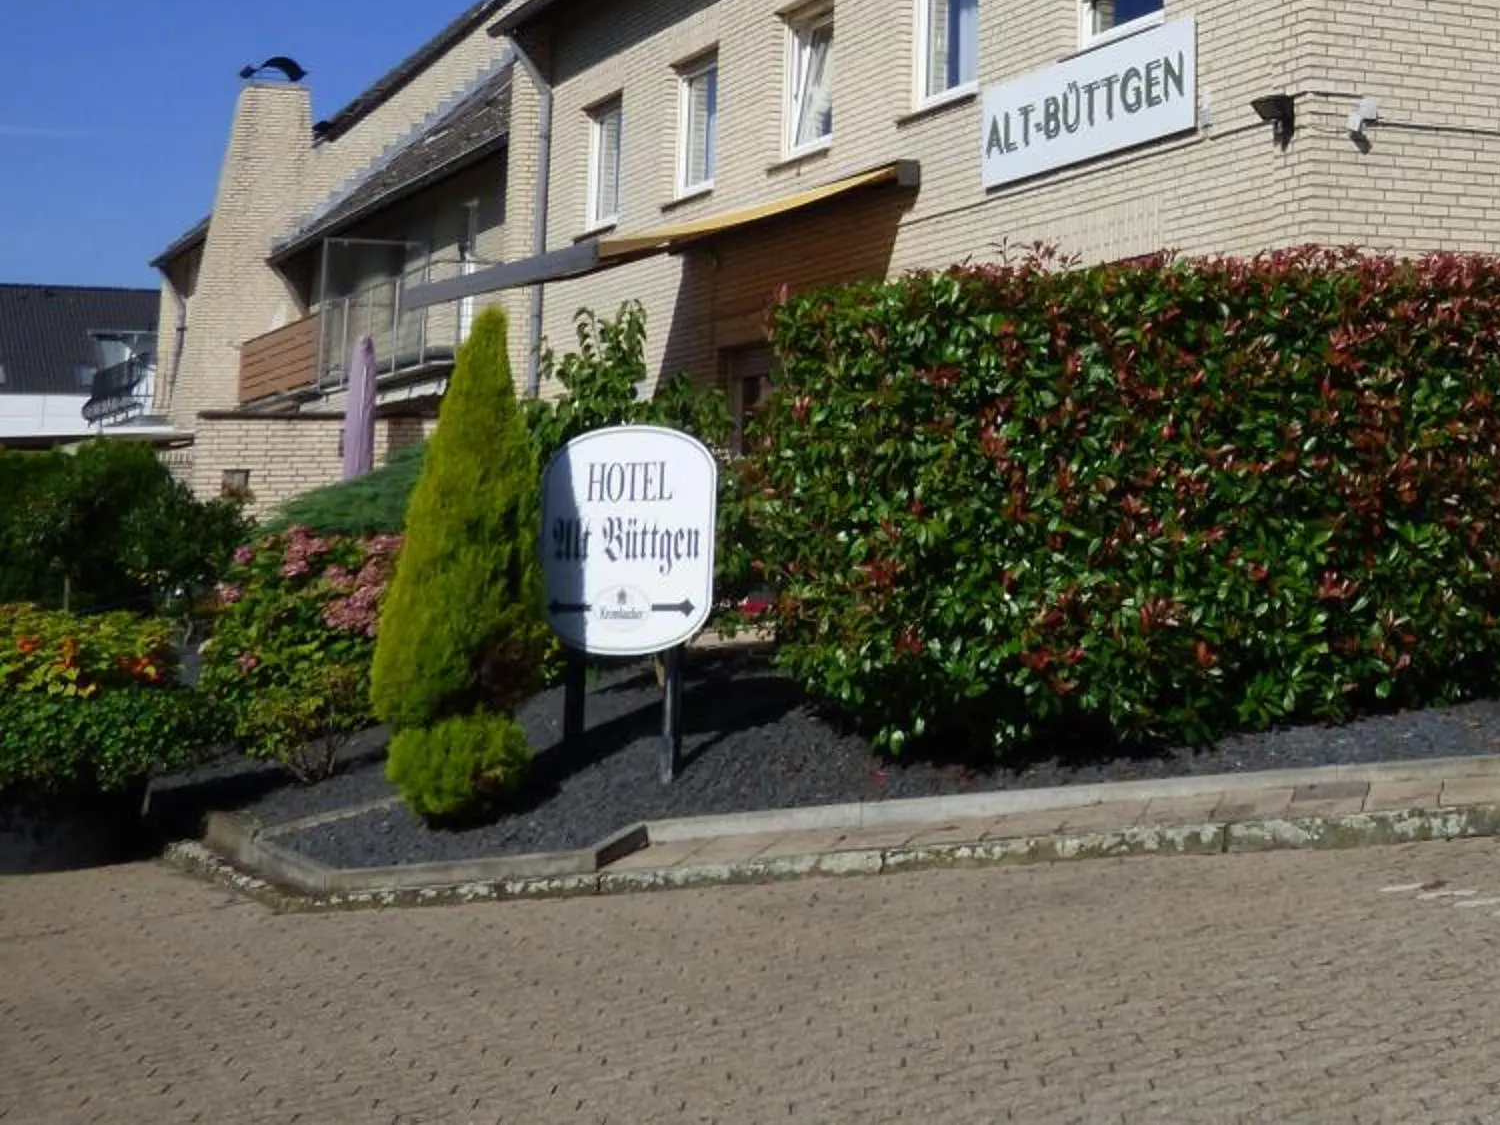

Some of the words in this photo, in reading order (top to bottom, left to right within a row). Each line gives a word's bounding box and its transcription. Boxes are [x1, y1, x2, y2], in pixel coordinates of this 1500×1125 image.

[986, 50, 1184, 159] ALT-BÜTTGEN
[586, 461, 673, 503] HOTEL
[602, 516, 700, 575] Büttgen
